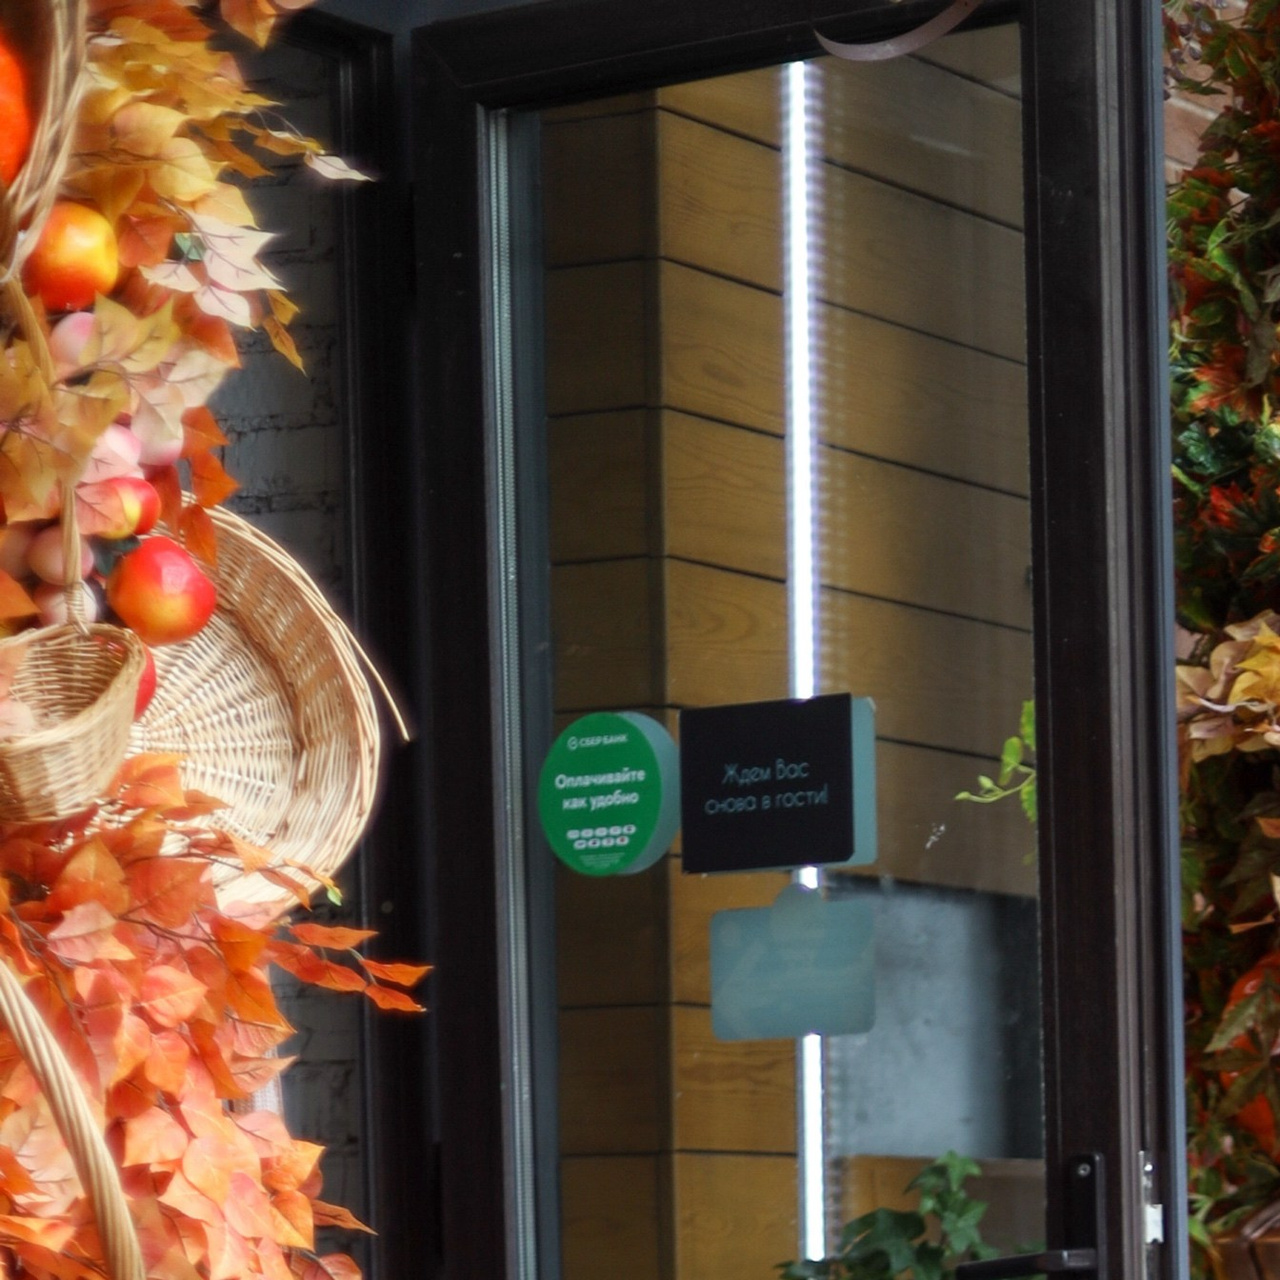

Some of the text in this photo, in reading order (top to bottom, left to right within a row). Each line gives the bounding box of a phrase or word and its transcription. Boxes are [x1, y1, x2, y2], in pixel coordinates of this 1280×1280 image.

[578, 733, 629, 748] СБЕРБАНК
[555, 767, 646, 789] Оплачивайте
[721, 763, 772, 786] Ждем
[562, 789, 639, 811] как удобно
[704, 795, 757, 815] снова
[775, 782, 828, 808] гости!
